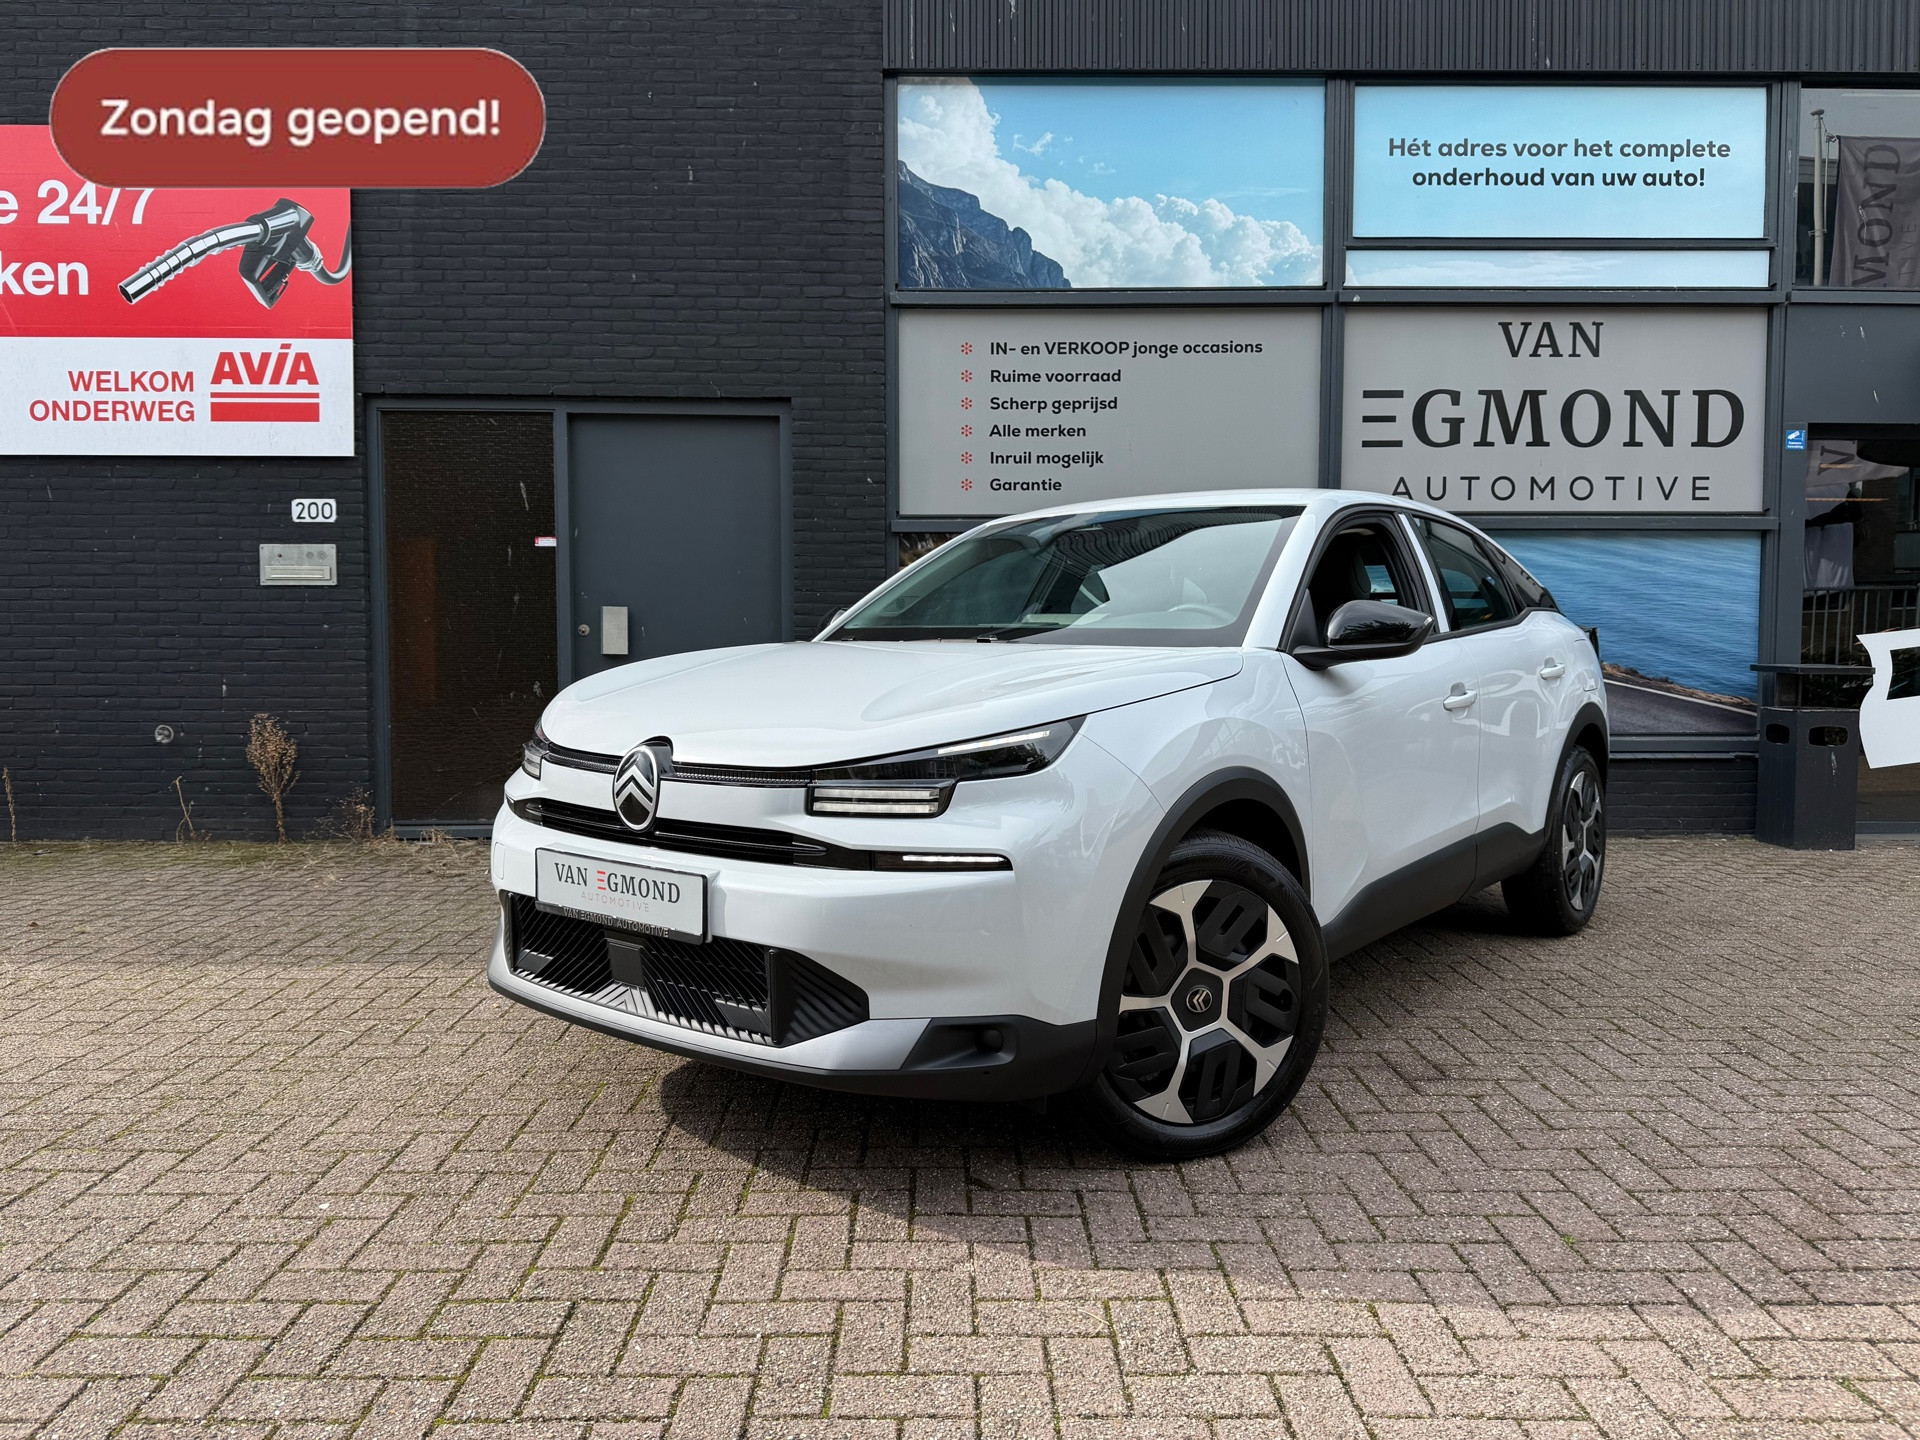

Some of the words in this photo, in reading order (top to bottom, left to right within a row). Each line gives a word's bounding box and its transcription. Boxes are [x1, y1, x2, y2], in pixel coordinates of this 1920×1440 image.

[1388, 137, 1432, 157] Hét
[1437, 138, 1508, 158] adres
[1512, 143, 1569, 158] voor
[1573, 138, 1614, 158] het
[1619, 138, 1731, 163] complete
[1412, 167, 1545, 187] onderhoud
[1550, 172, 1595, 187] van
[1602, 172, 1637, 187] uw
[1642, 167, 1705, 187] auto!
[37, 179, 155, 226] 24/7
[990, 341, 1017, 355] IN-
[1020, 345, 1041, 356] en
[1043, 341, 1130, 356] VERKOOP
[1132, 341, 1179, 359] jonge
[1182, 339, 1263, 354] occasions
[1497, 320, 1604, 358] VAN
[67, 370, 194, 393] WELKOM
[990, 369, 1042, 383] Ruime
[1045, 368, 1122, 383] voorraad
[29, 399, 195, 423] ONDERWEG
[990, 396, 1048, 414] Scherp
[1052, 396, 1118, 415] geprijsd
[1361, 388, 1745, 449] EGMOND
[989, 424, 1021, 438] Alle
[1025, 424, 1087, 438] merken
[990, 451, 1032, 465] Inruil
[1036, 450, 1104, 469] mogelijk
[989, 477, 1063, 492] Garantie
[1391, 475, 1710, 502] AUTOMOTIVE
[294, 501, 333, 521] 200
[554, 862, 588, 887] VAN
[596, 869, 681, 904] EGMOND
[581, 891, 650, 913] AUTOMOTIVE
[563, 906, 579, 920] VAN
[580, 910, 613, 926] EGMOND
[616, 918, 669, 938] AUTOMOTIVE
